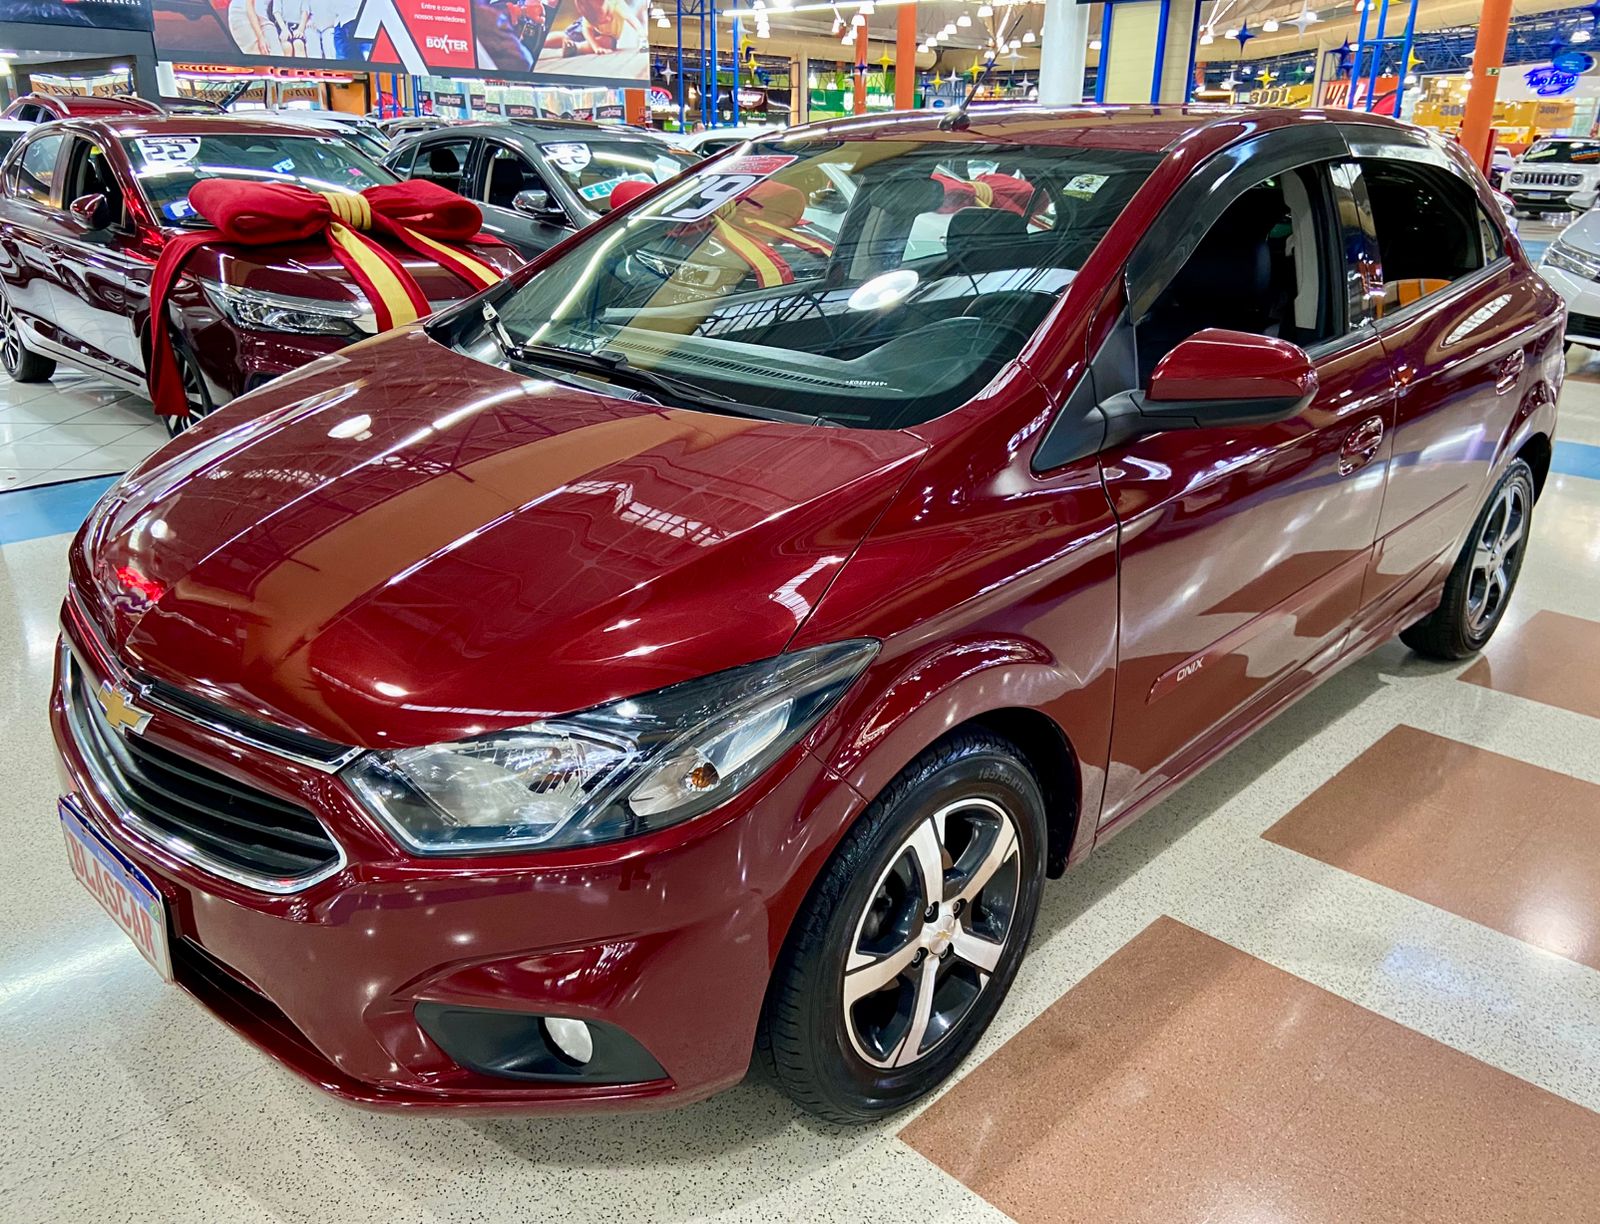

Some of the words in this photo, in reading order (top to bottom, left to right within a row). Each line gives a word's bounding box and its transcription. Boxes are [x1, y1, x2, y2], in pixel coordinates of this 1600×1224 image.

[421, 2, 436, 10] Entre
[434, 16, 466, 24] vendedores
[426, 34, 469, 54] BOXTER
[1176, 656, 1204, 682] ONIX
[66, 834, 157, 961] BLASCAR
